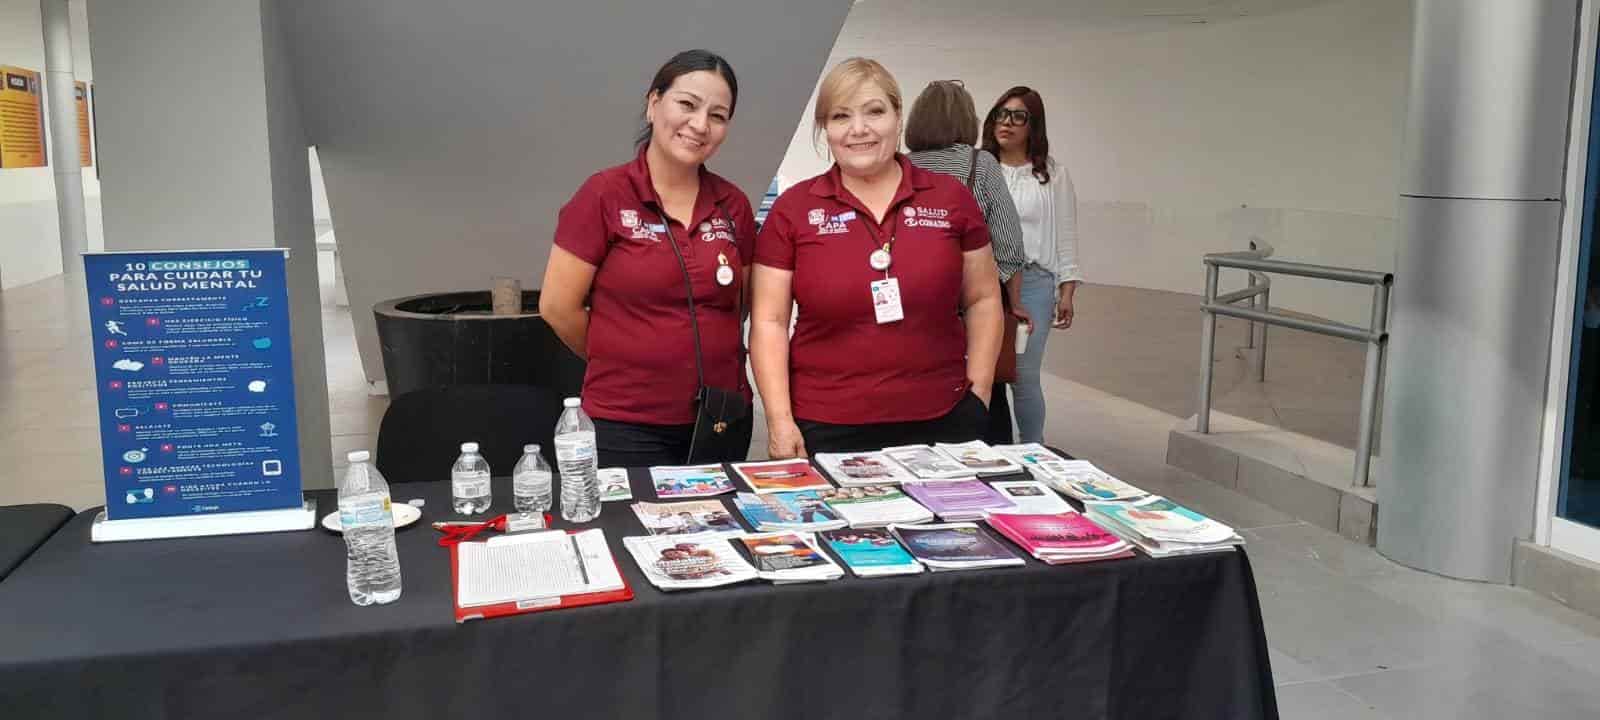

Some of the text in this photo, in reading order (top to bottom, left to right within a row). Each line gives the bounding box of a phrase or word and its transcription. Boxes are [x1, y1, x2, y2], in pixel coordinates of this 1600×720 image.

[126, 260, 247, 271] 10 CONSEJOS
[109, 270, 263, 282] PARA CUIDAR TU
[117, 280, 257, 292] SALUD MENTAL
